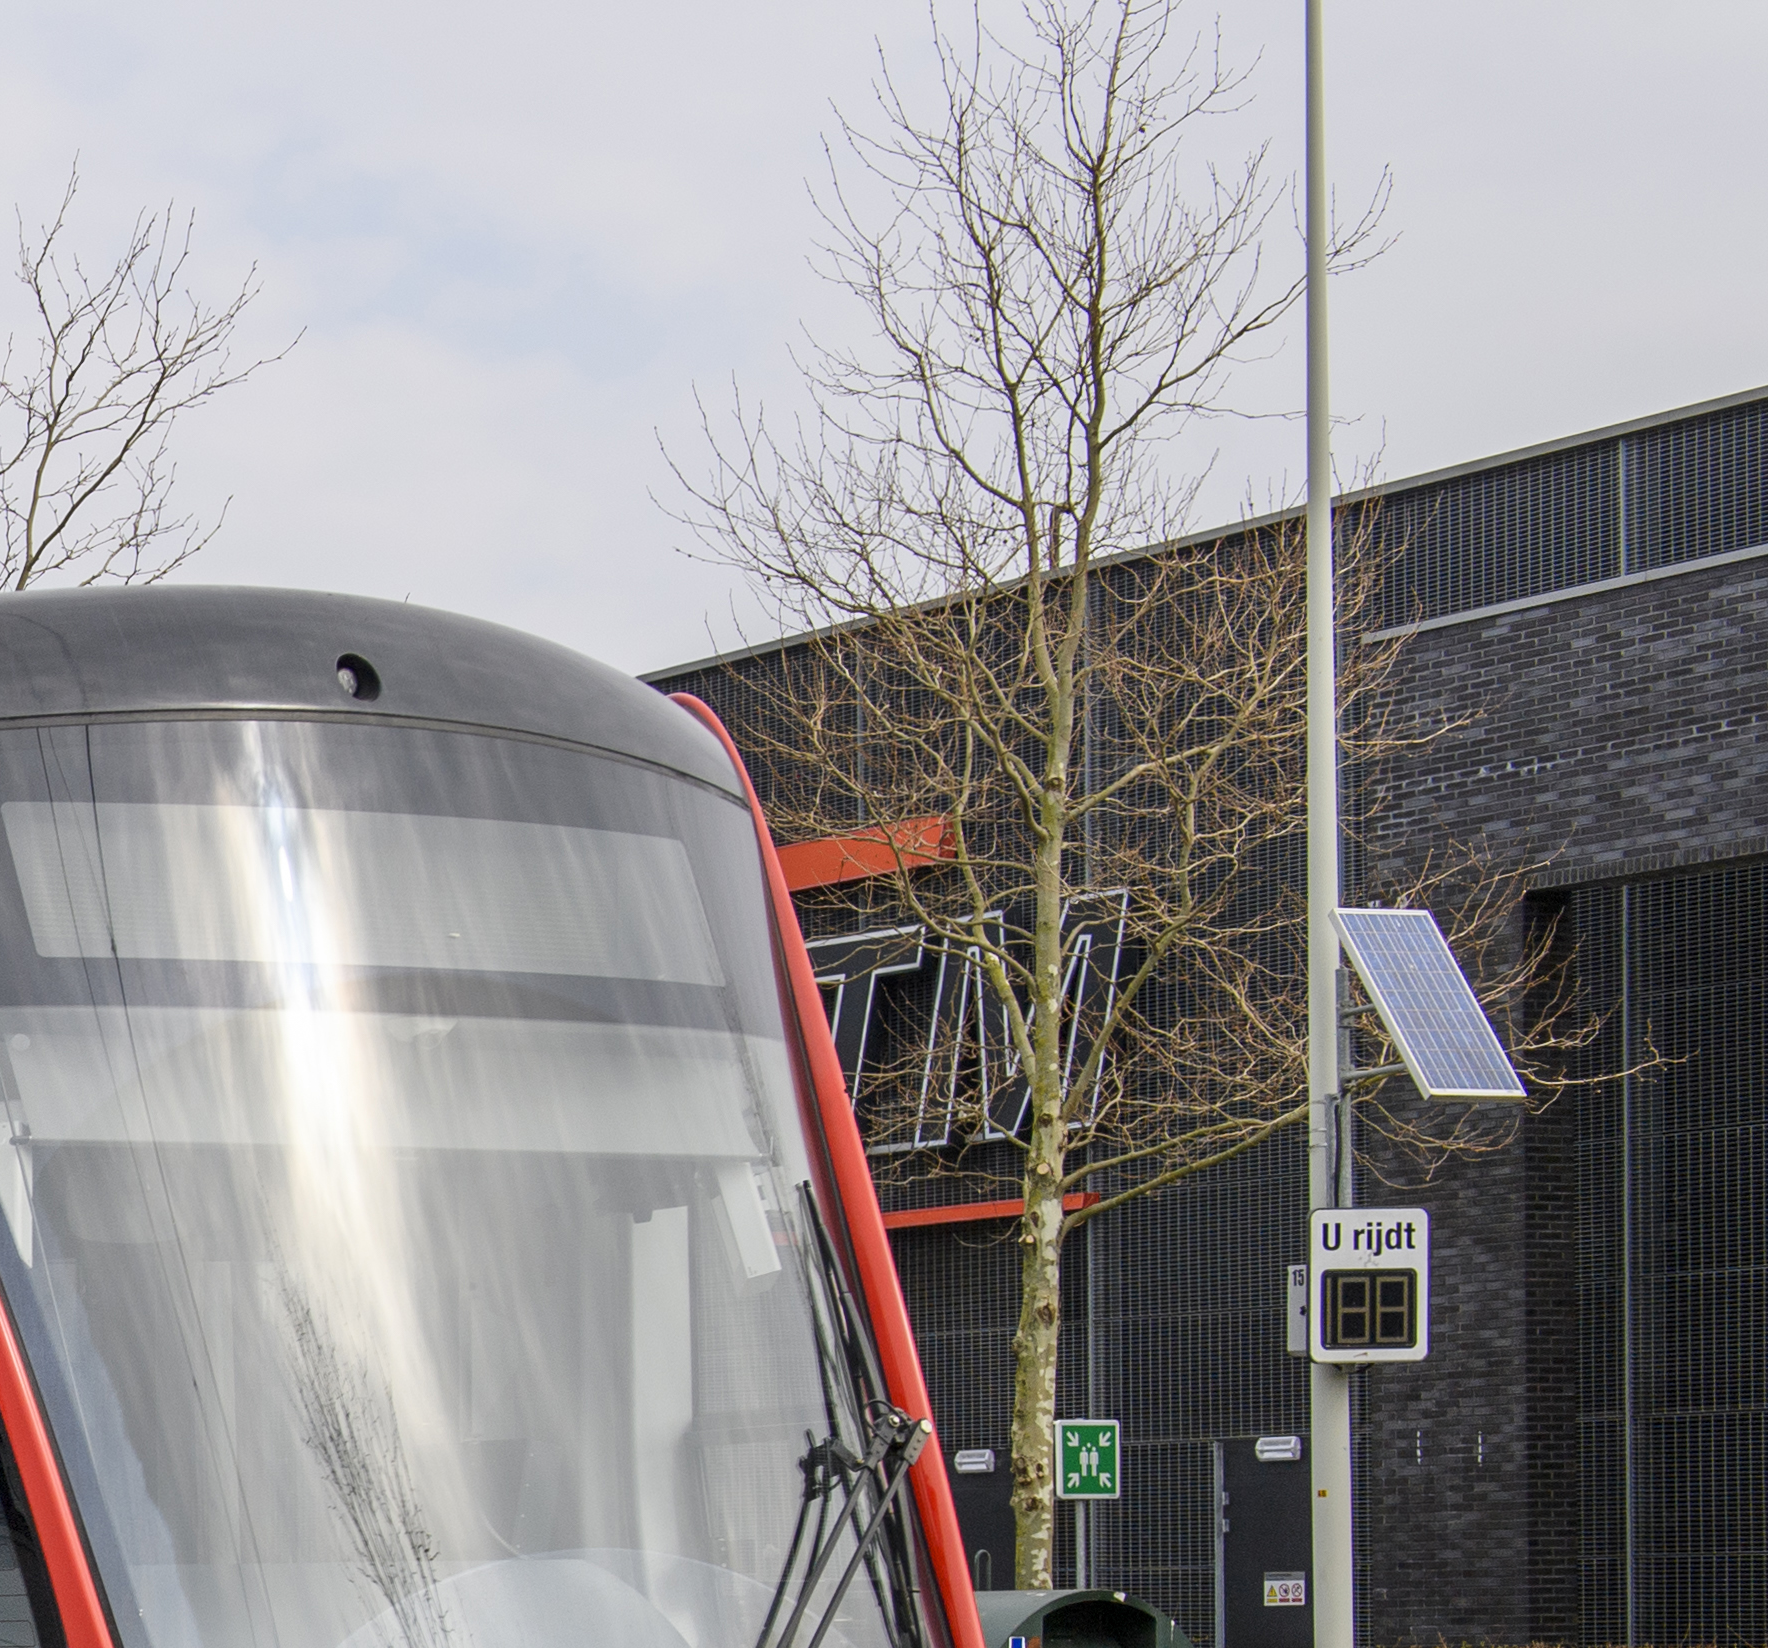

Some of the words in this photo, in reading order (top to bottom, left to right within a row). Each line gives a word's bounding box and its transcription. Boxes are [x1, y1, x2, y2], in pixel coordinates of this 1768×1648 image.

[1321, 1222, 1342, 1251] U
[1353, 1222, 1416, 1257] rijdt
[1292, 1268, 1305, 1287] 15
